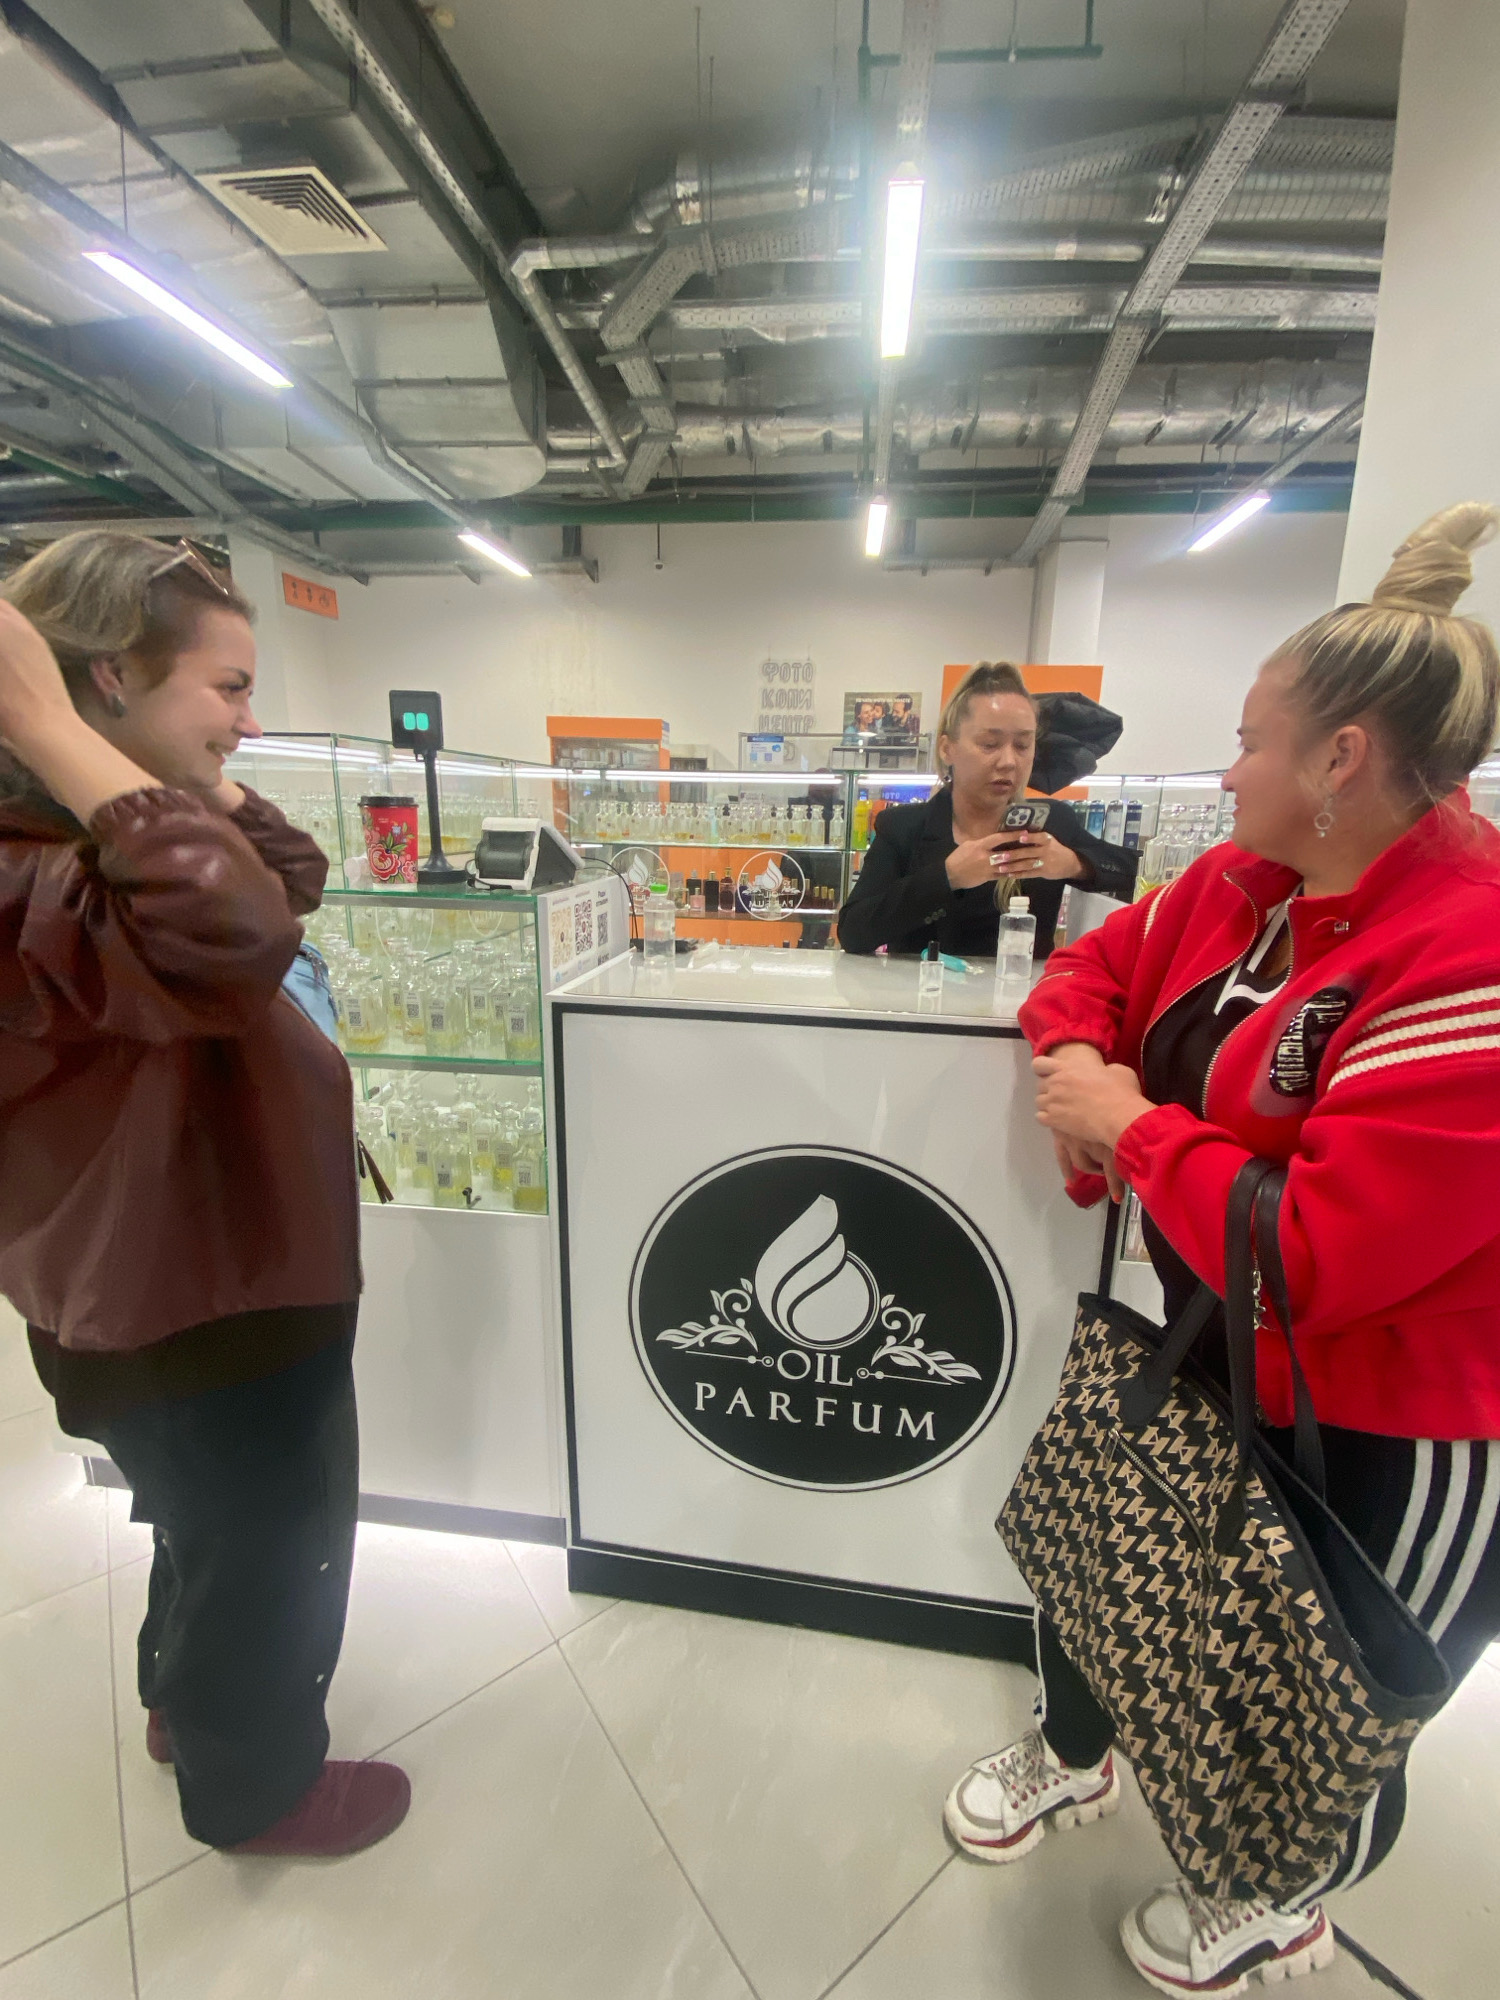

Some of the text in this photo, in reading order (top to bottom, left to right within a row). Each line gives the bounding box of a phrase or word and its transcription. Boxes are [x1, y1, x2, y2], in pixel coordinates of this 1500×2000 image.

[761, 662, 814, 683] ФОТО
[761, 688, 813, 710] КОПИ
[758, 714, 814, 734] ЦЕНТР
[777, 1349, 853, 1387] OIL
[694, 1382, 936, 1441] PARFUM
